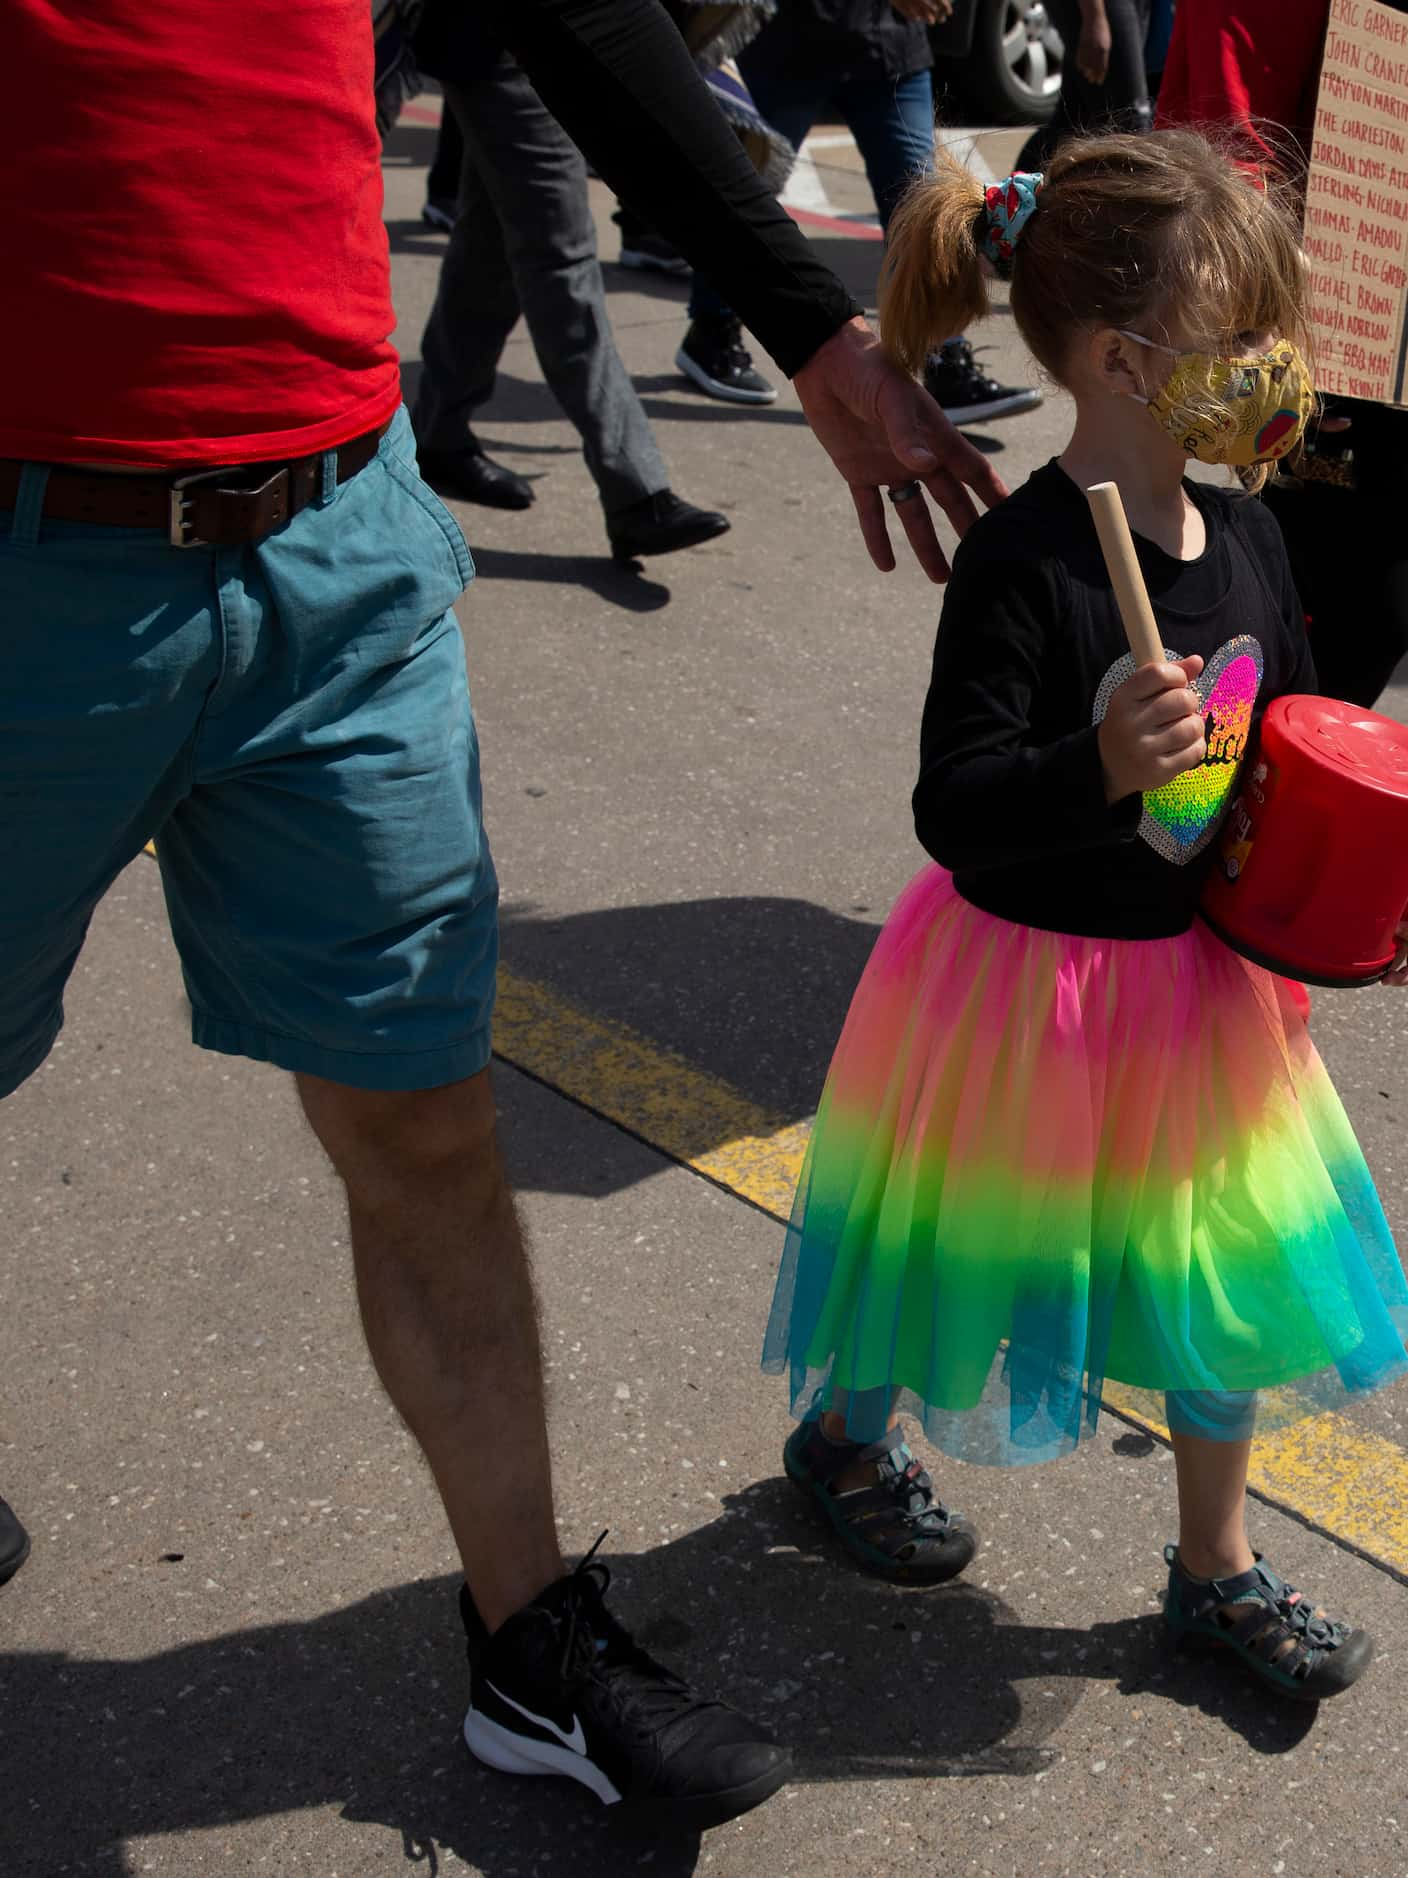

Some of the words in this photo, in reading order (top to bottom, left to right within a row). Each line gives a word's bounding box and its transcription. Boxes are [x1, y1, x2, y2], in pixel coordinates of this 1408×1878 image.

[1331, 0, 1360, 28] ERIC
[1363, 8, 1408, 48] GARNER
[1326, 31, 1361, 69] JOHN
[1322, 72, 1372, 107] TRAYVON
[1317, 109, 1337, 132] THE
[1342, 119, 1405, 155] CHARLESTON
[1313, 140, 1355, 174] JORDAN
[1310, 173, 1362, 207] STERLING
[1306, 206, 1350, 233] THOMAS
[1357, 219, 1402, 252] AMADOU
[1351, 248, 1379, 277] ERIC
[1357, 284, 1393, 316] BROWN
